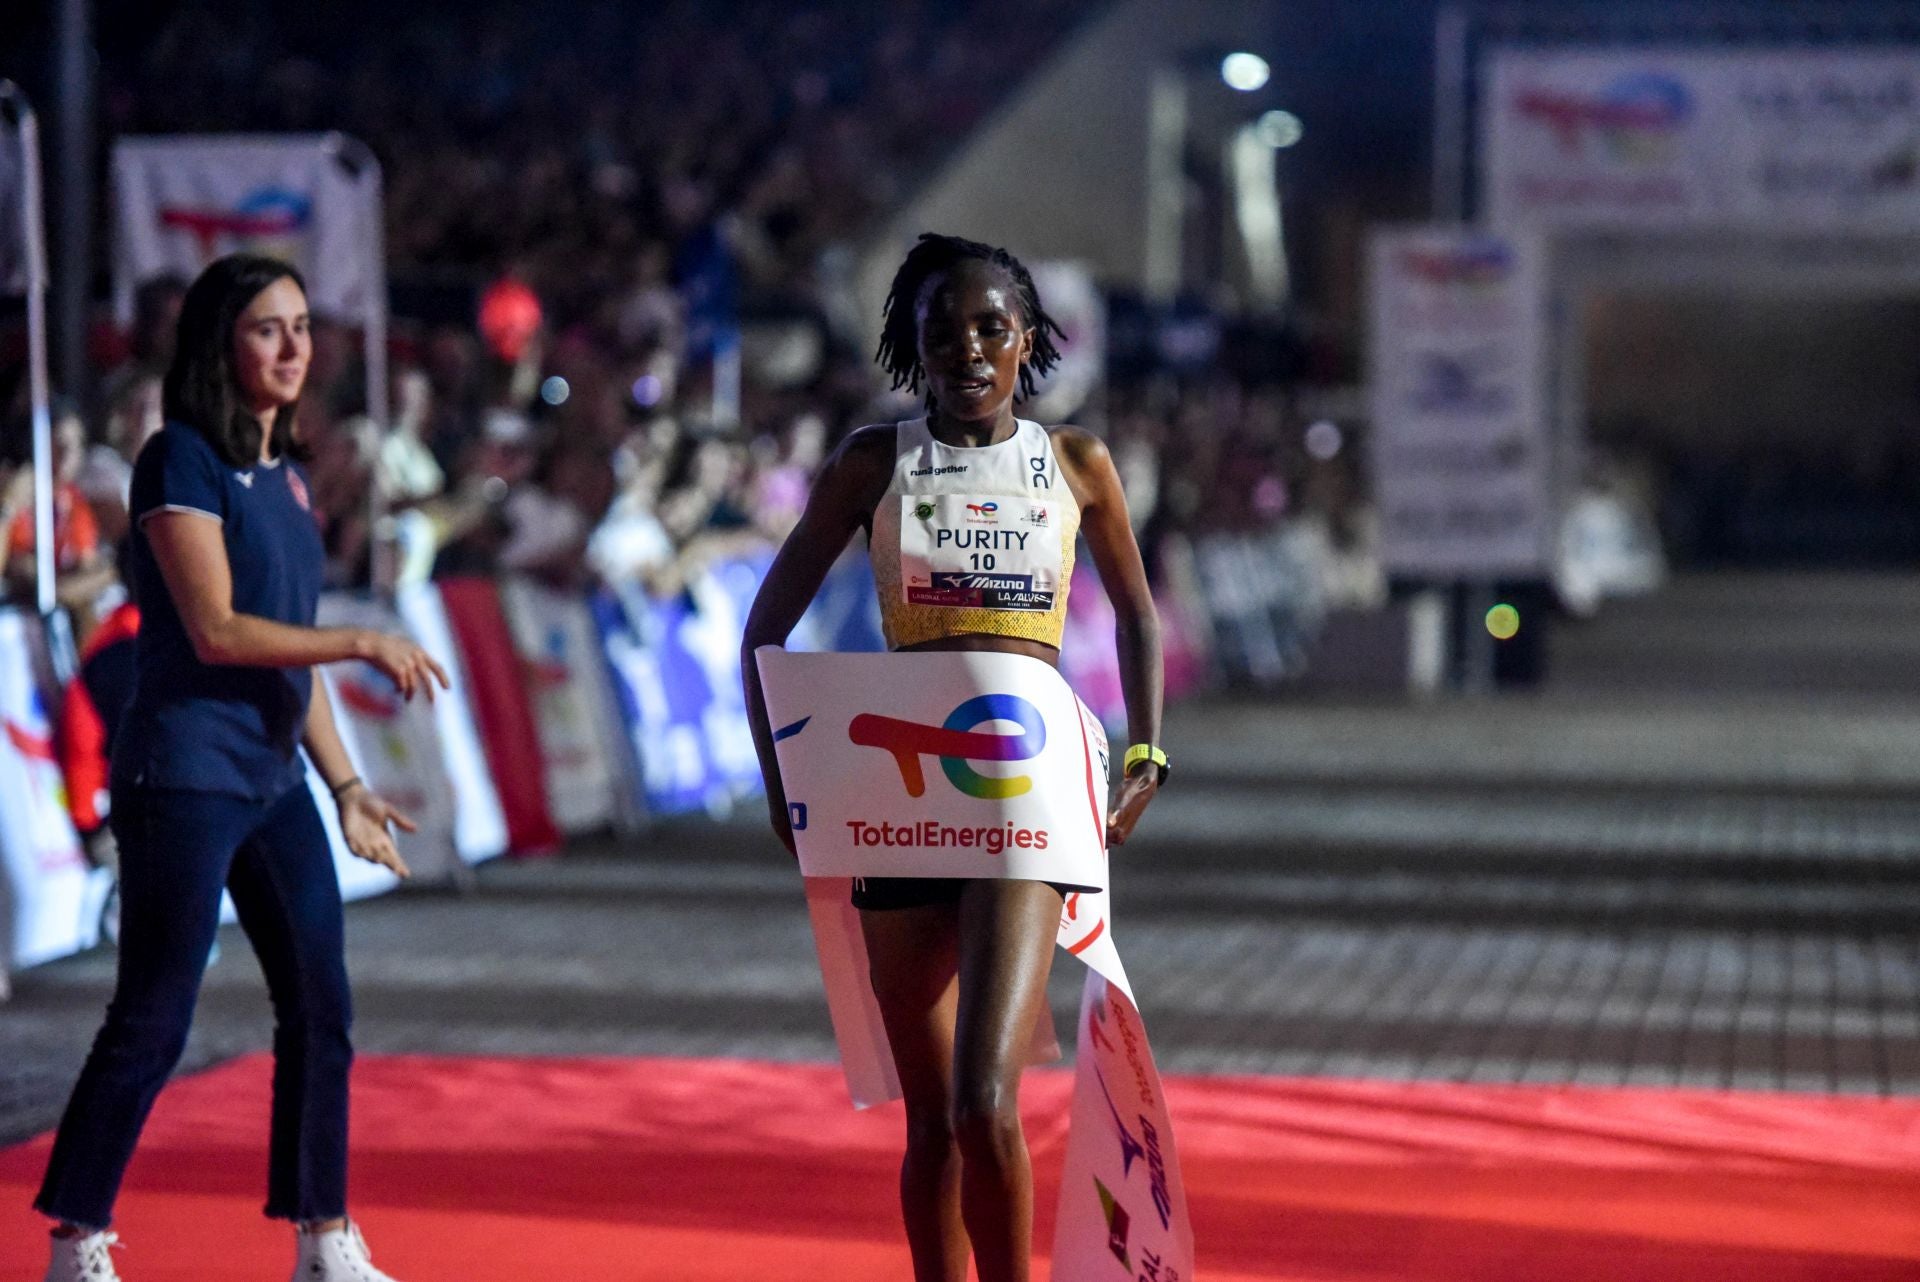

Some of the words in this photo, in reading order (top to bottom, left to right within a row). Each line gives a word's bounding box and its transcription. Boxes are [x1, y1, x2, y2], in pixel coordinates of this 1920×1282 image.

[910, 465, 968, 476] run2gether
[937, 529, 1030, 550] PURITY
[969, 553, 996, 571] 10
[998, 592, 1011, 601] LA
[846, 821, 1049, 855] TotalEnergies
